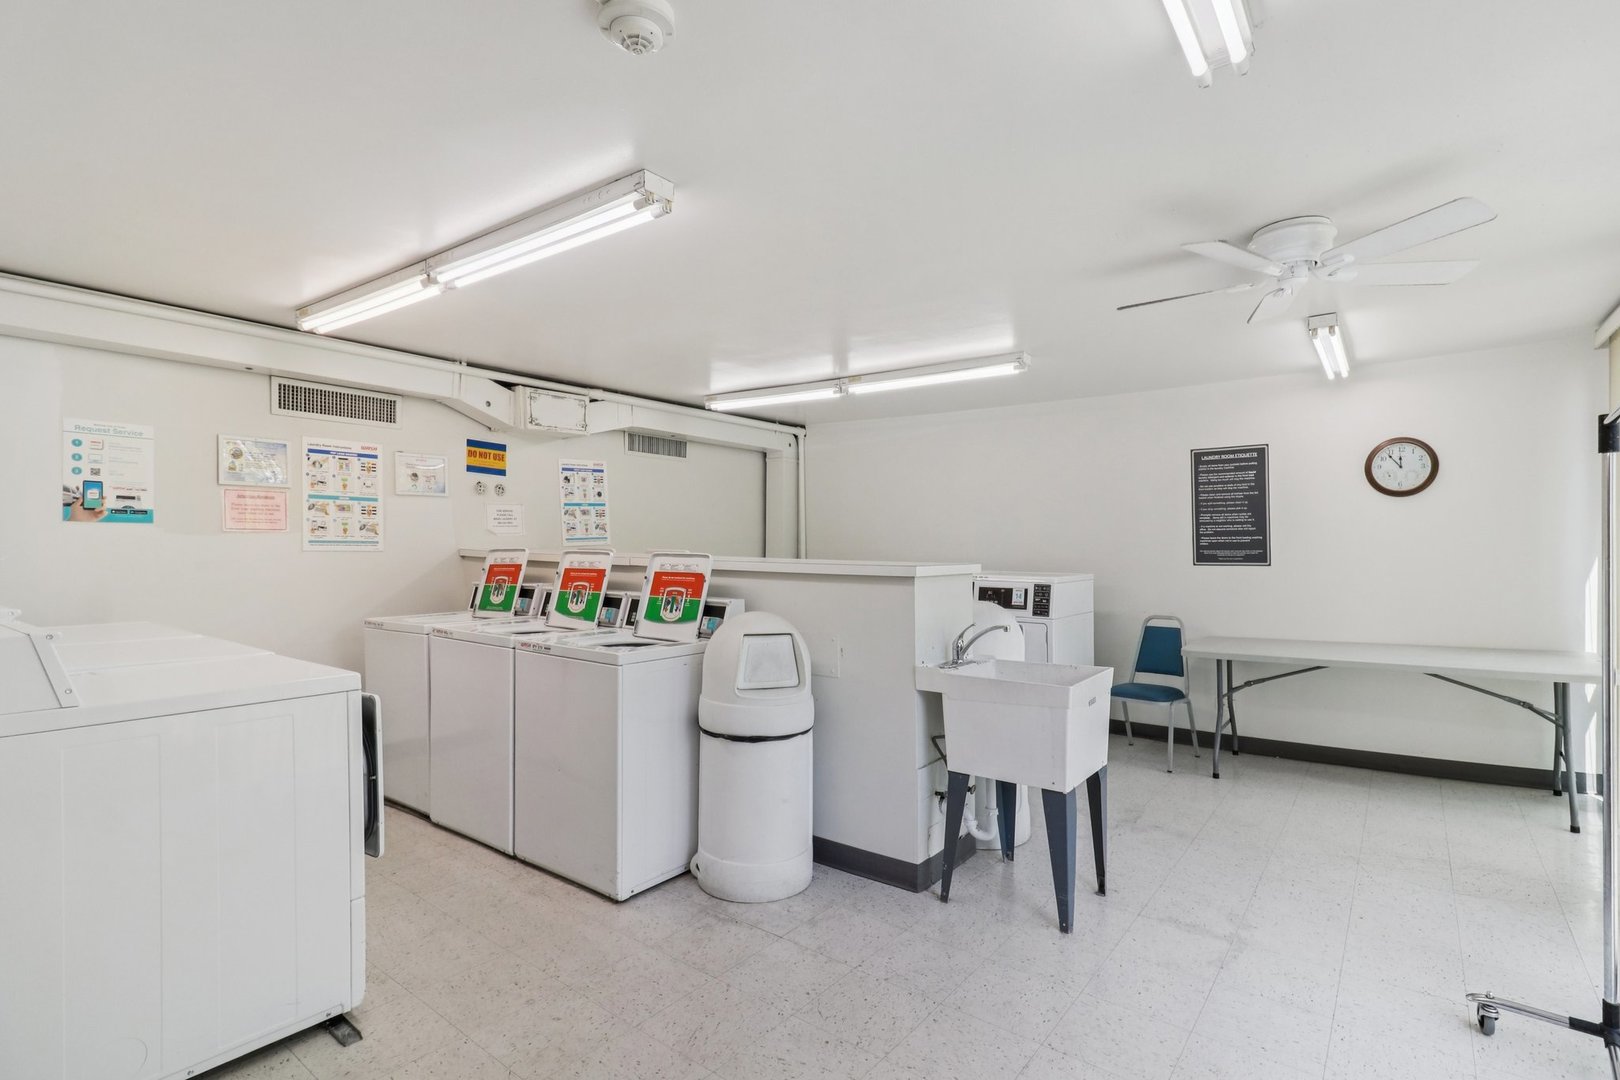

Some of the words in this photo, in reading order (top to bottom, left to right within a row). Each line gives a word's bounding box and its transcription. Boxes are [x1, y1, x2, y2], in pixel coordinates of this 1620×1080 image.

[74, 424, 111, 433] Request
[112, 428, 144, 437] Service
[468, 449, 478, 458] DO
[479, 450, 492, 460] NOT
[493, 453, 505, 462] USE
